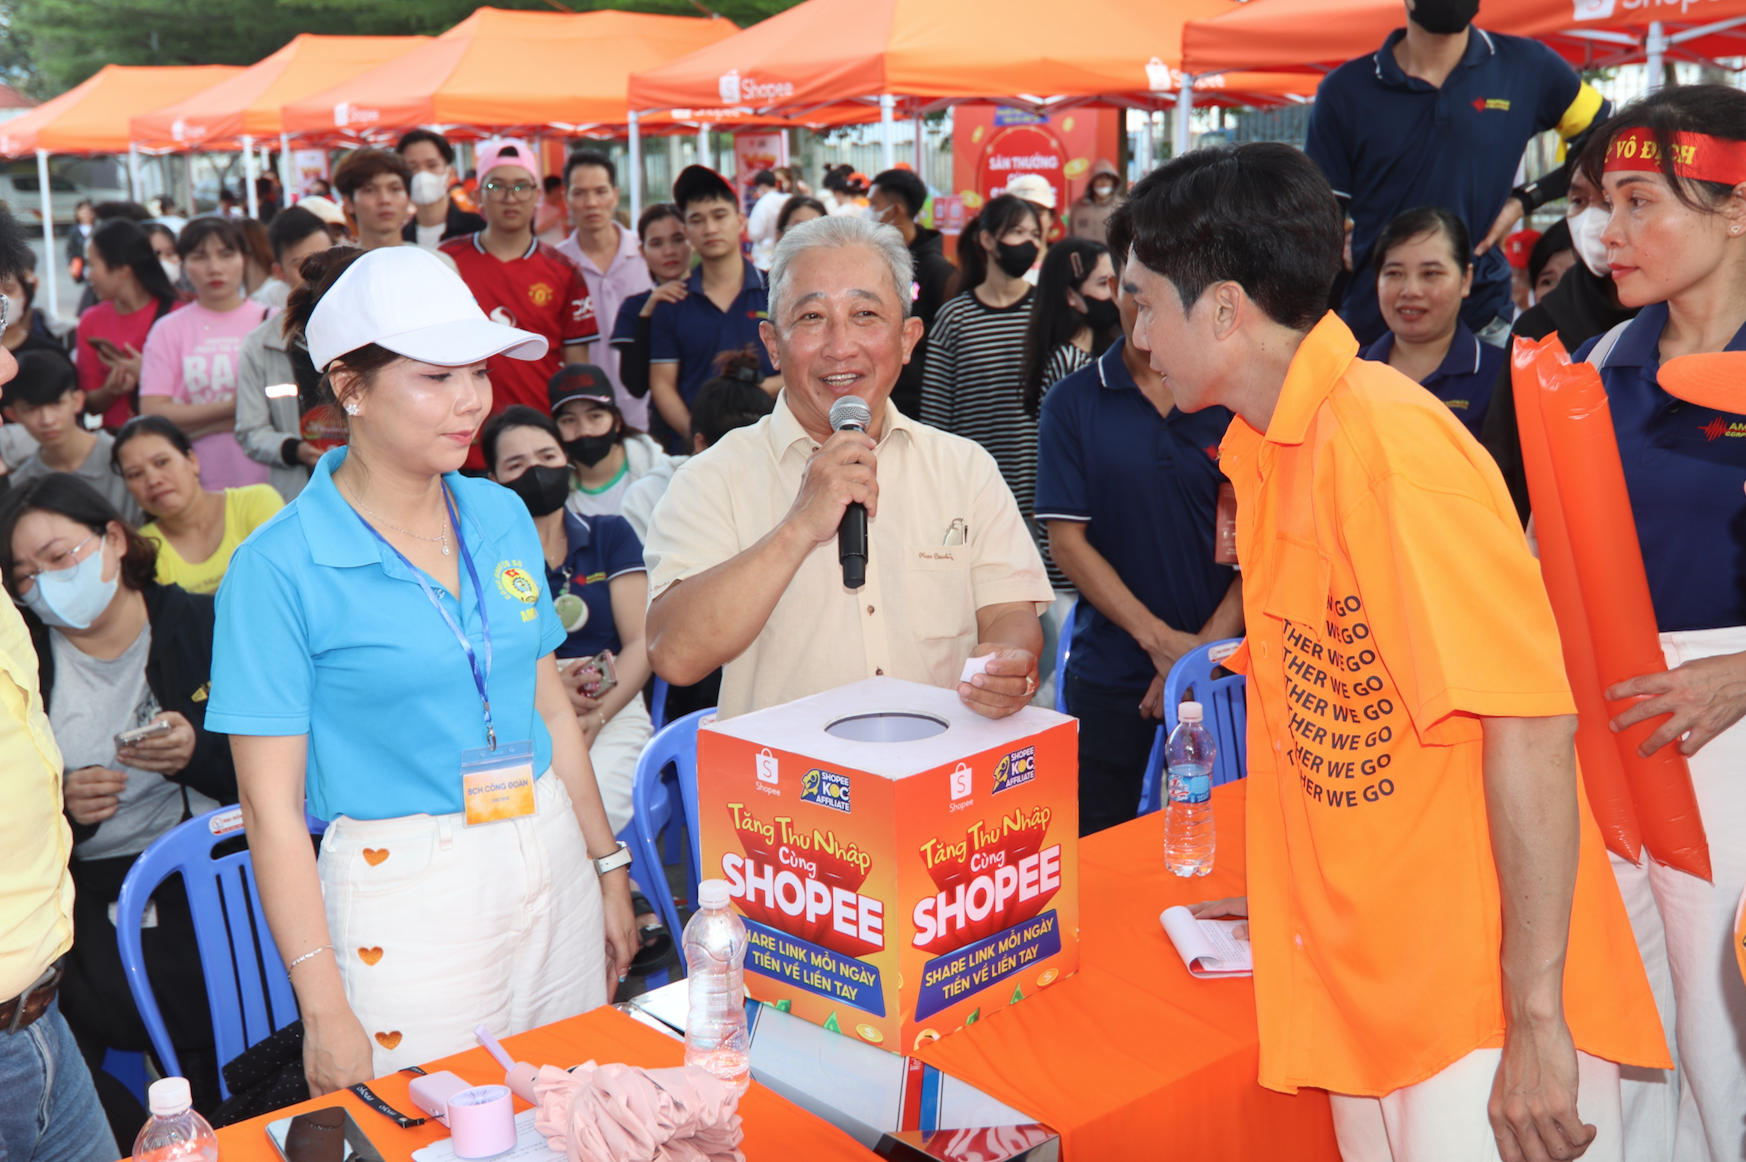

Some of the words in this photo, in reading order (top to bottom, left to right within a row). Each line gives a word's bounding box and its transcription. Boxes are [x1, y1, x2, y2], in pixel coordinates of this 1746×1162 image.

[741, 78, 795, 104] Shopee
[1616, 135, 1638, 159] VÔ
[1335, 595, 1361, 617] GO
[1341, 623, 1369, 645] GO
[1346, 649, 1376, 672] GO
[1330, 676, 1351, 699] WE
[1353, 675, 1383, 696] GO
[1333, 704, 1361, 723] WE
[1363, 698, 1394, 721] GO
[1331, 732, 1361, 751] WE
[1364, 726, 1392, 748] GO
[1010, 746, 1035, 762] SHOPEE
[1328, 760, 1355, 779] WE
[1361, 753, 1391, 776] GO
[467, 786, 484, 796] BCH
[484, 782, 507, 793] CÔNG
[508, 779, 529, 789] ĐOÀN
[755, 781, 781, 797] Shopee
[821, 771, 850, 787] SHOPEE
[1005, 771, 1035, 788] AFFILIATE
[815, 794, 851, 812] AFFILIATE
[1326, 789, 1358, 808] WE
[1363, 778, 1395, 803] GO
[949, 799, 974, 813] Shopee
[727, 803, 774, 846] Tăng
[774, 816, 811, 850] Thu
[813, 829, 871, 876] Nhập
[920, 837, 967, 869] Tăng
[967, 820, 1000, 851] Thu
[1002, 806, 1050, 837] Nhập
[778, 846, 817, 878] Cùng
[970, 850, 1006, 873] Cùng
[721, 852, 884, 948] SHOPEE
[912, 844, 1060, 947] SHOPEE
[746, 929, 776, 951] HARE
[779, 940, 808, 963] LINK
[810, 950, 836, 974] MỖI
[839, 962, 877, 988] NGÀY
[925, 956, 966, 988] SHARE
[968, 943, 996, 968] LINK
[998, 929, 1021, 954] MỖI
[1023, 917, 1054, 943] NGÀY
[752, 950, 780, 973] TIỀN
[783, 961, 800, 980] VỀ
[803, 970, 831, 992] LIỀN
[834, 981, 858, 1001] TAY
[942, 975, 970, 1000] TIỀN
[972, 962, 989, 986] VỀ
[991, 953, 1017, 978] LIỀN
[1018, 943, 1040, 964] TAY
